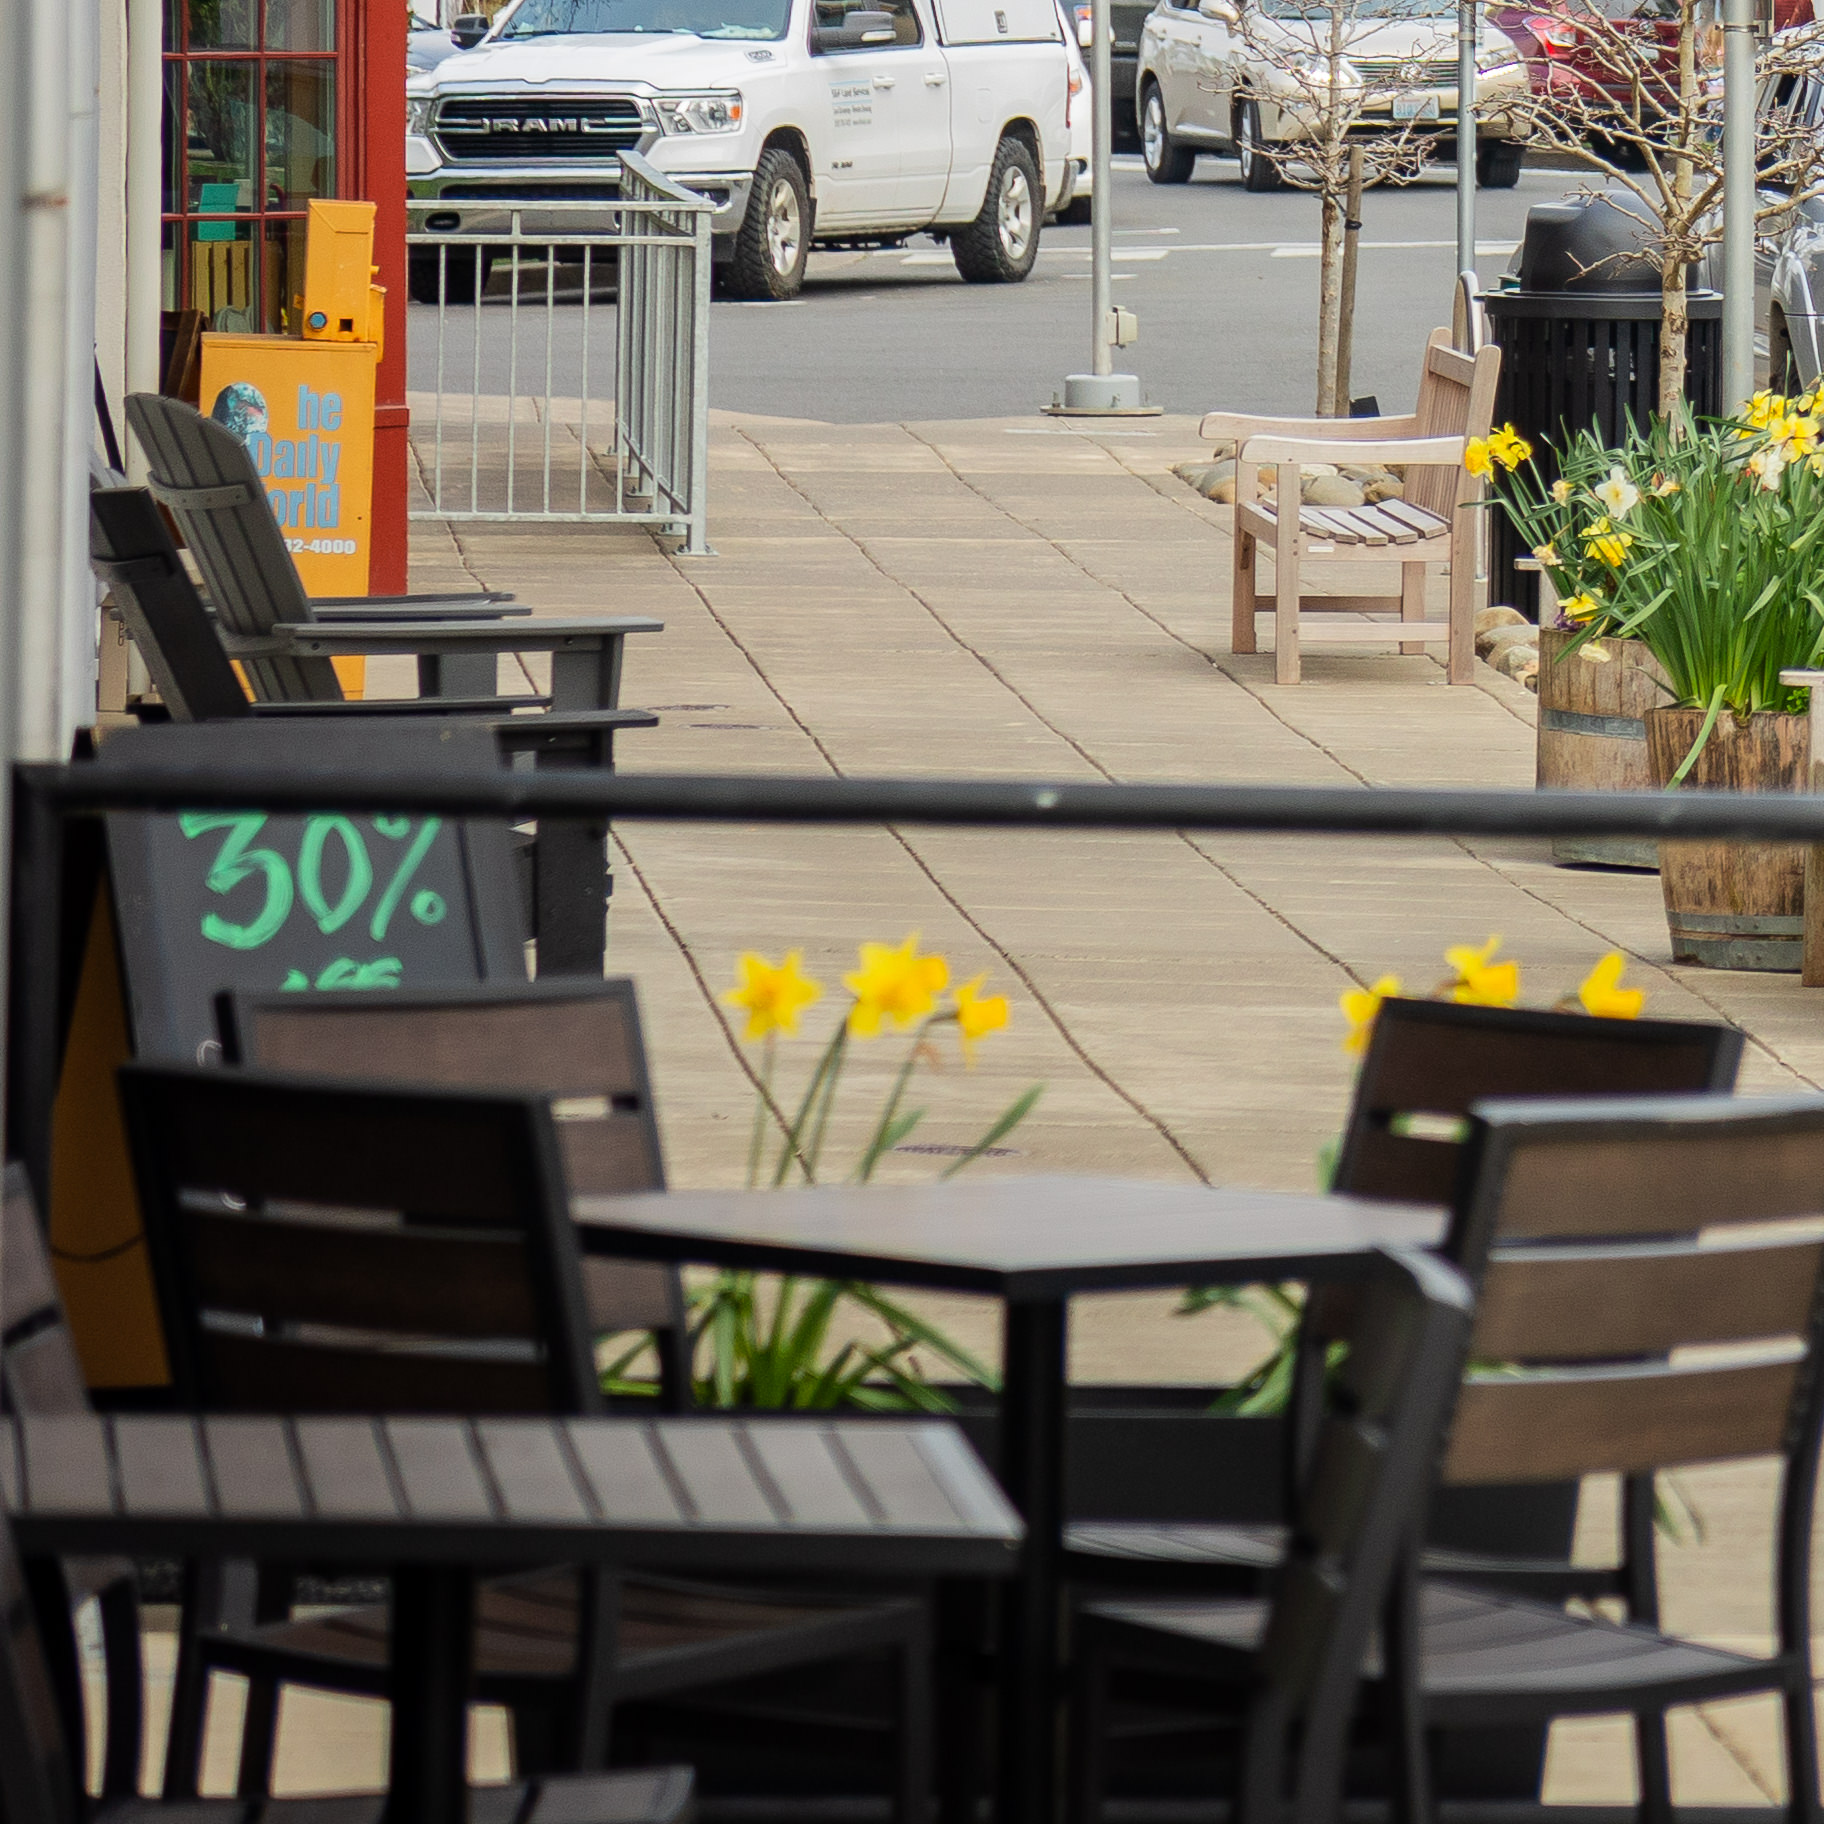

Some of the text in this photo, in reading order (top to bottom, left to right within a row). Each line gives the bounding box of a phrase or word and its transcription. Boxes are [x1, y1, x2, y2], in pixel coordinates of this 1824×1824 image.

[492, 118, 578, 132] RAM
[249, 431, 341, 485] Daily
[264, 482, 339, 529] orld
[284, 537, 357, 555] 32-4000
[179, 813, 446, 950] 30%
